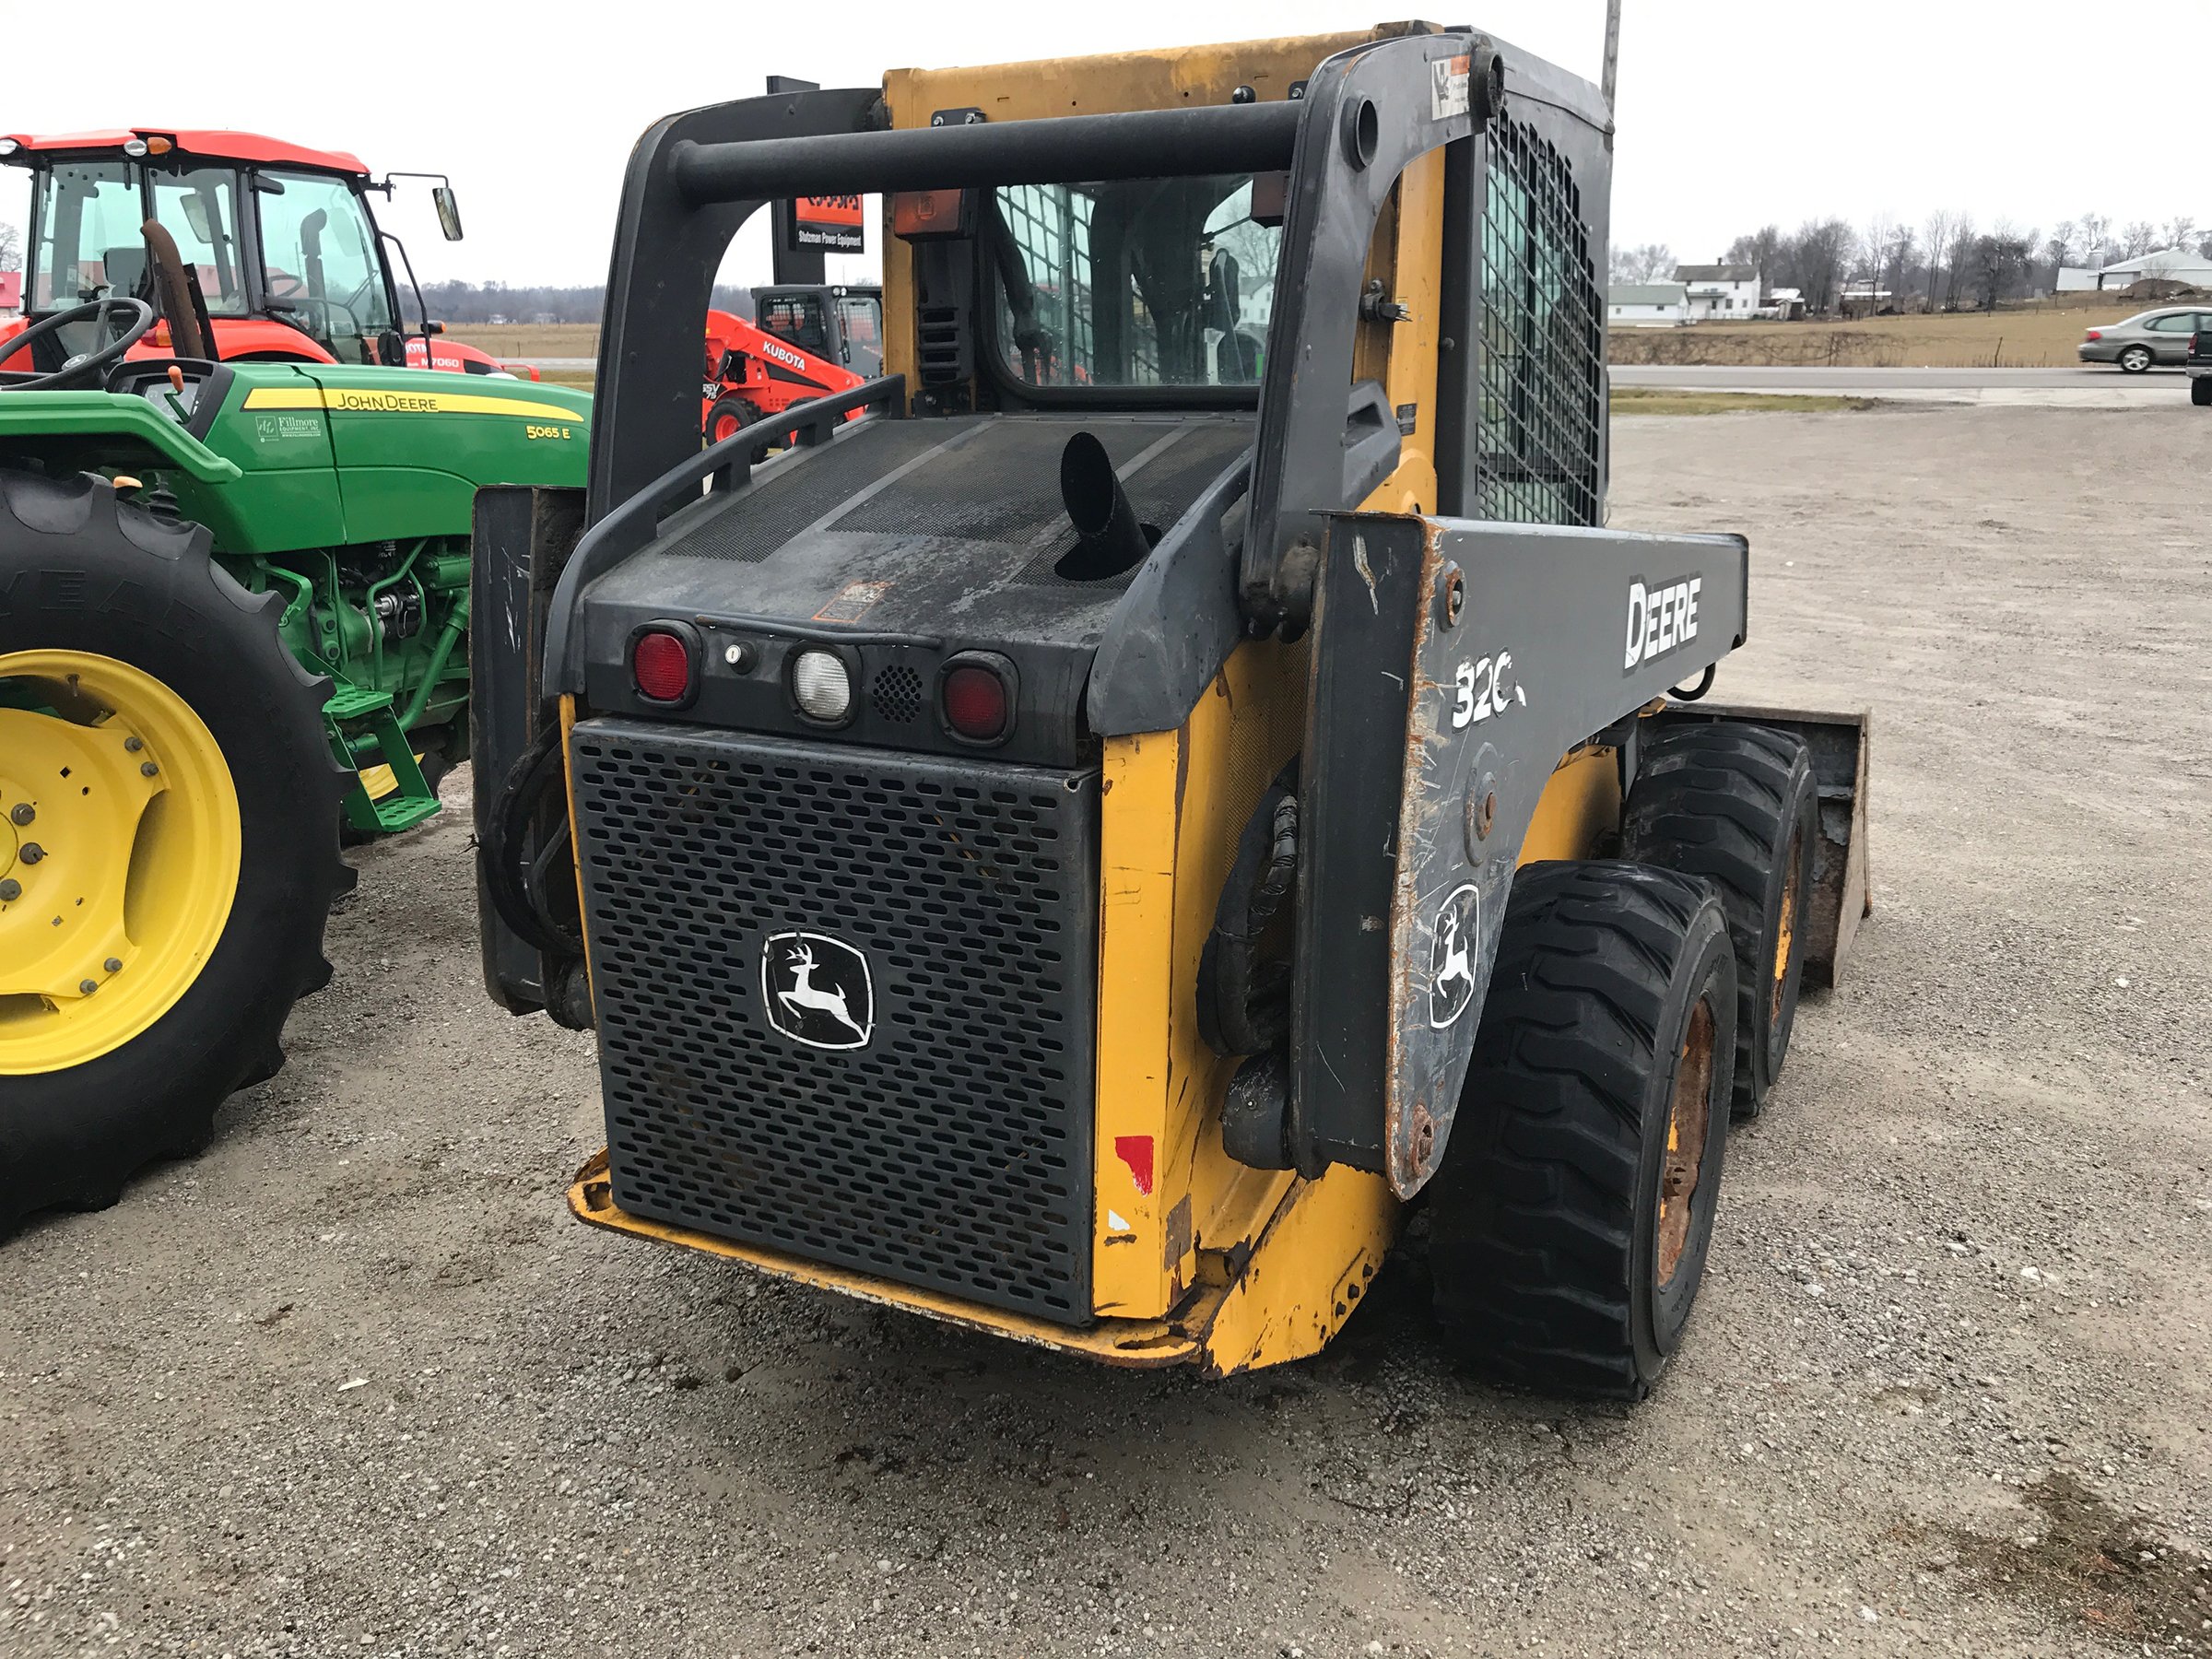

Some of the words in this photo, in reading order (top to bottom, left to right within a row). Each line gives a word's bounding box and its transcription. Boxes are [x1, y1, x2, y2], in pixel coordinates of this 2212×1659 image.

[837, 233, 862, 248] Equipment
[763, 341, 806, 371] KUBOTA
[278, 417, 319, 427] Fillmore
[526, 425, 559, 440] 5065
[562, 428, 571, 440] E
[1625, 577, 1701, 669] DEERE
